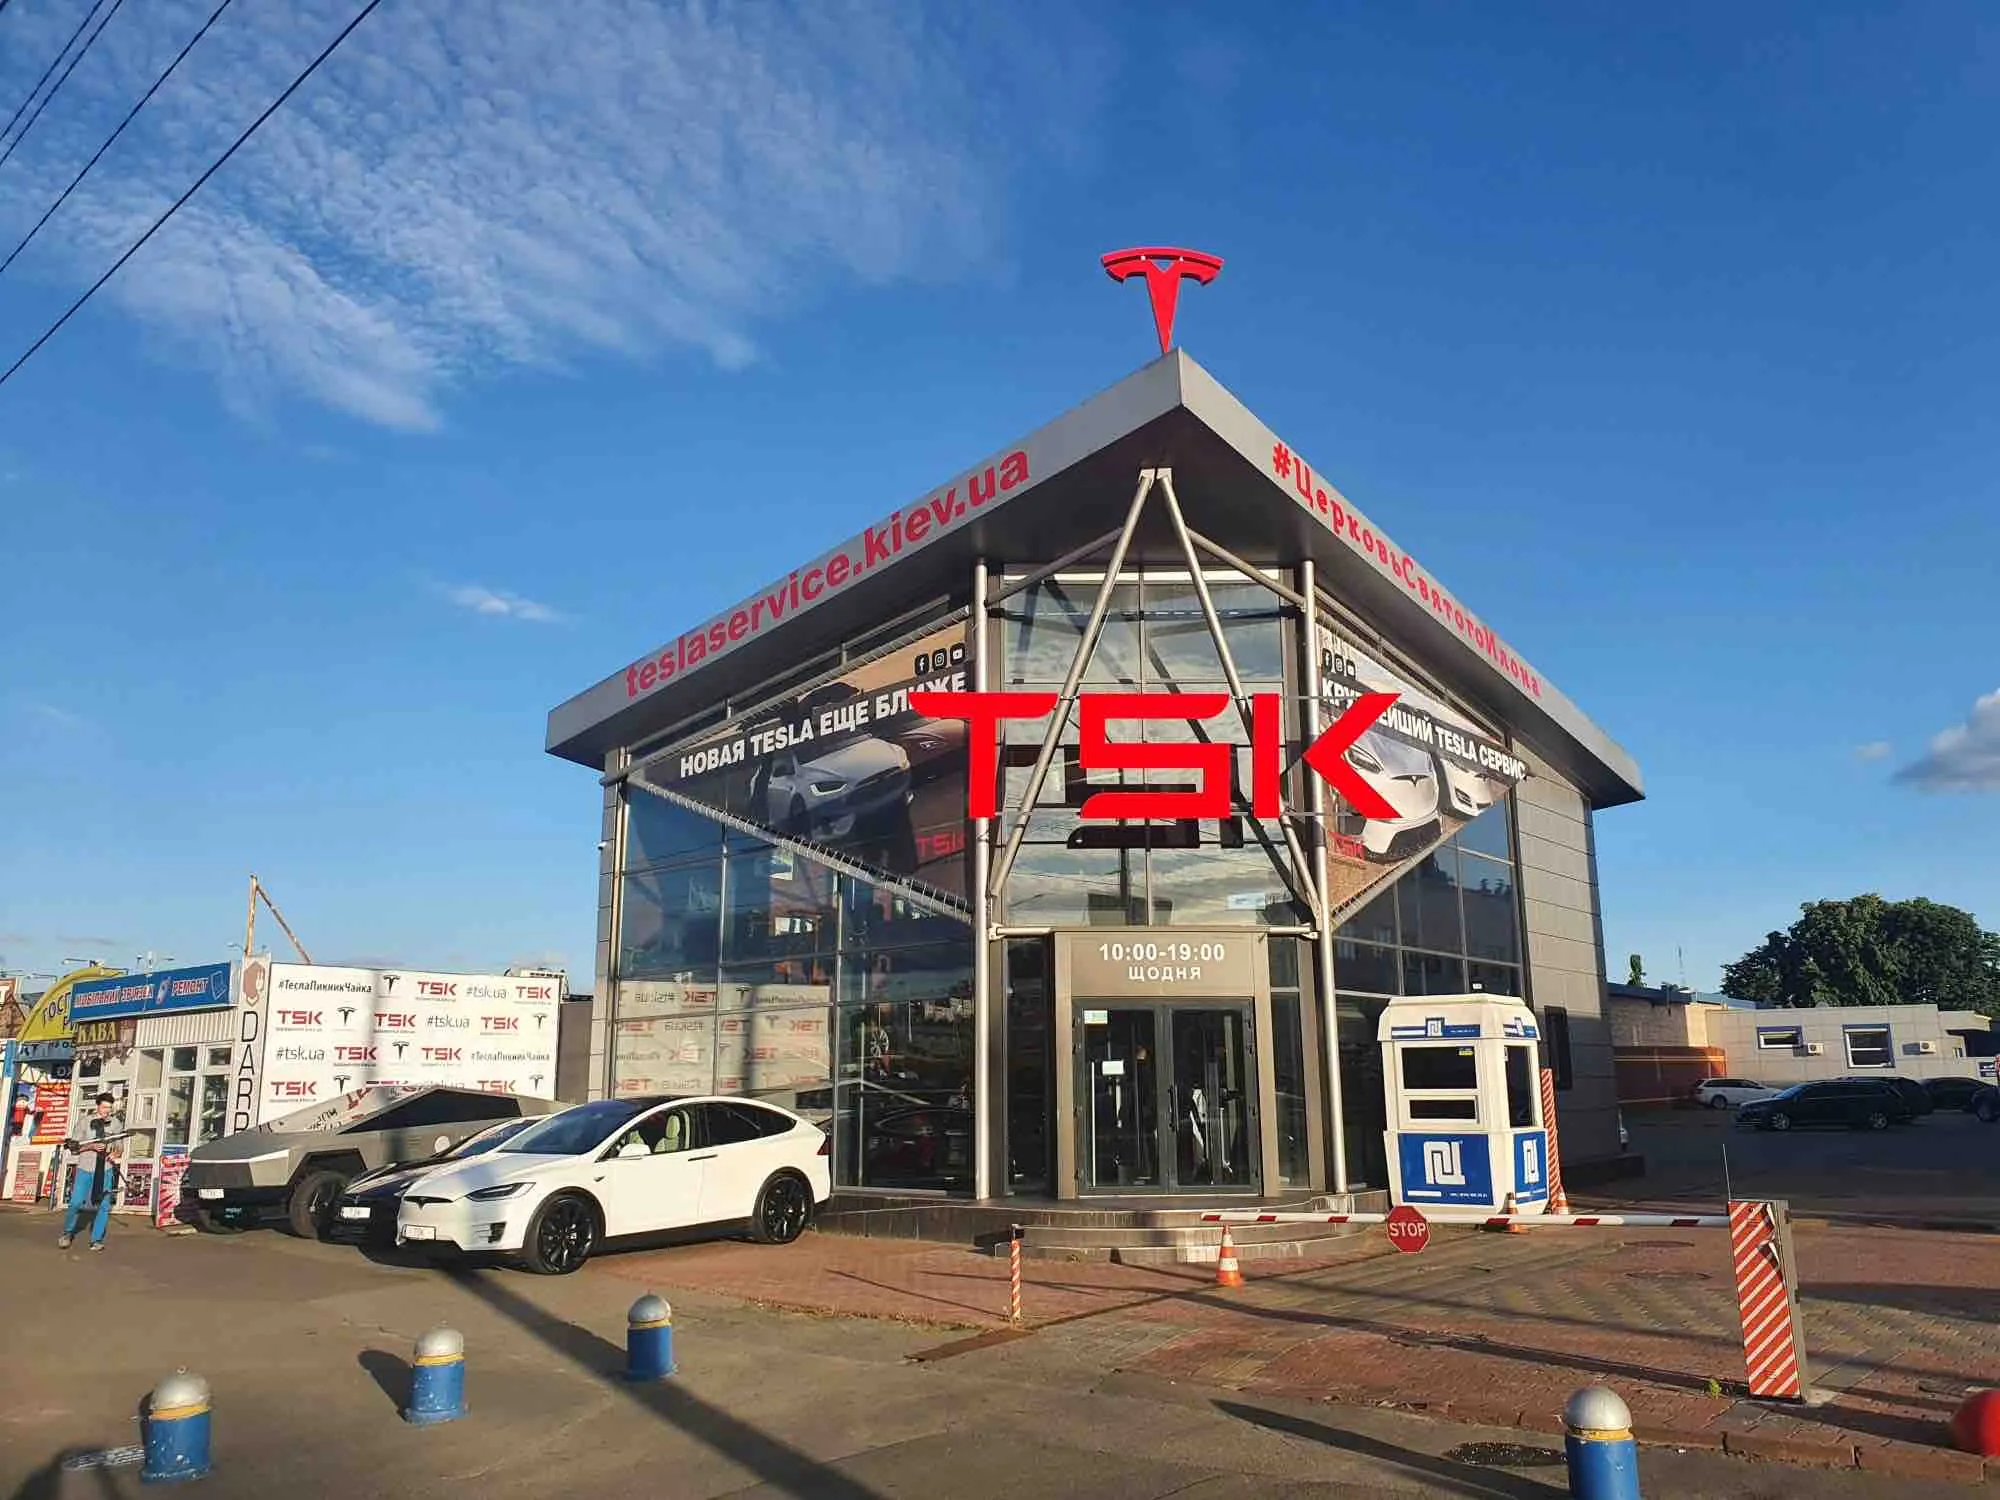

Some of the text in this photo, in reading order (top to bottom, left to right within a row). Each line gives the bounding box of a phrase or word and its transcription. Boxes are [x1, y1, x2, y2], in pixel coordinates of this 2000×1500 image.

[625, 449, 1030, 698] teslaservice.kiev.ua
[1272, 442, 1543, 698] #ЦерковьСвятогоИлона
[680, 740, 746, 779] НОВАЯ
[750, 719, 815, 757] TESLA
[820, 700, 870, 736] ЕЩЕ
[908, 692, 1403, 819] TSK
[1437, 726, 1478, 762] TESLA
[1479, 744, 1527, 781] СЕРВИС
[1099, 943, 1225, 961] 10:00-19:00
[171, 976, 209, 998] РЕМОНТ
[417, 981, 457, 996] TSK
[515, 986, 552, 999] TSK
[277, 1010, 323, 1025] TSK
[374, 1013, 417, 1027] TSK
[480, 1016, 519, 1030] TSK
[78, 1021, 117, 1043] КАВА
[276, 1046, 325, 1061] #tsk.ua
[334, 1046, 378, 1061] TSK
[421, 1047, 462, 1061] TSK
[270, 1081, 317, 1096] TSK
[477, 1079, 517, 1094] TSK
[1389, 1222, 1426, 1237] STOP
